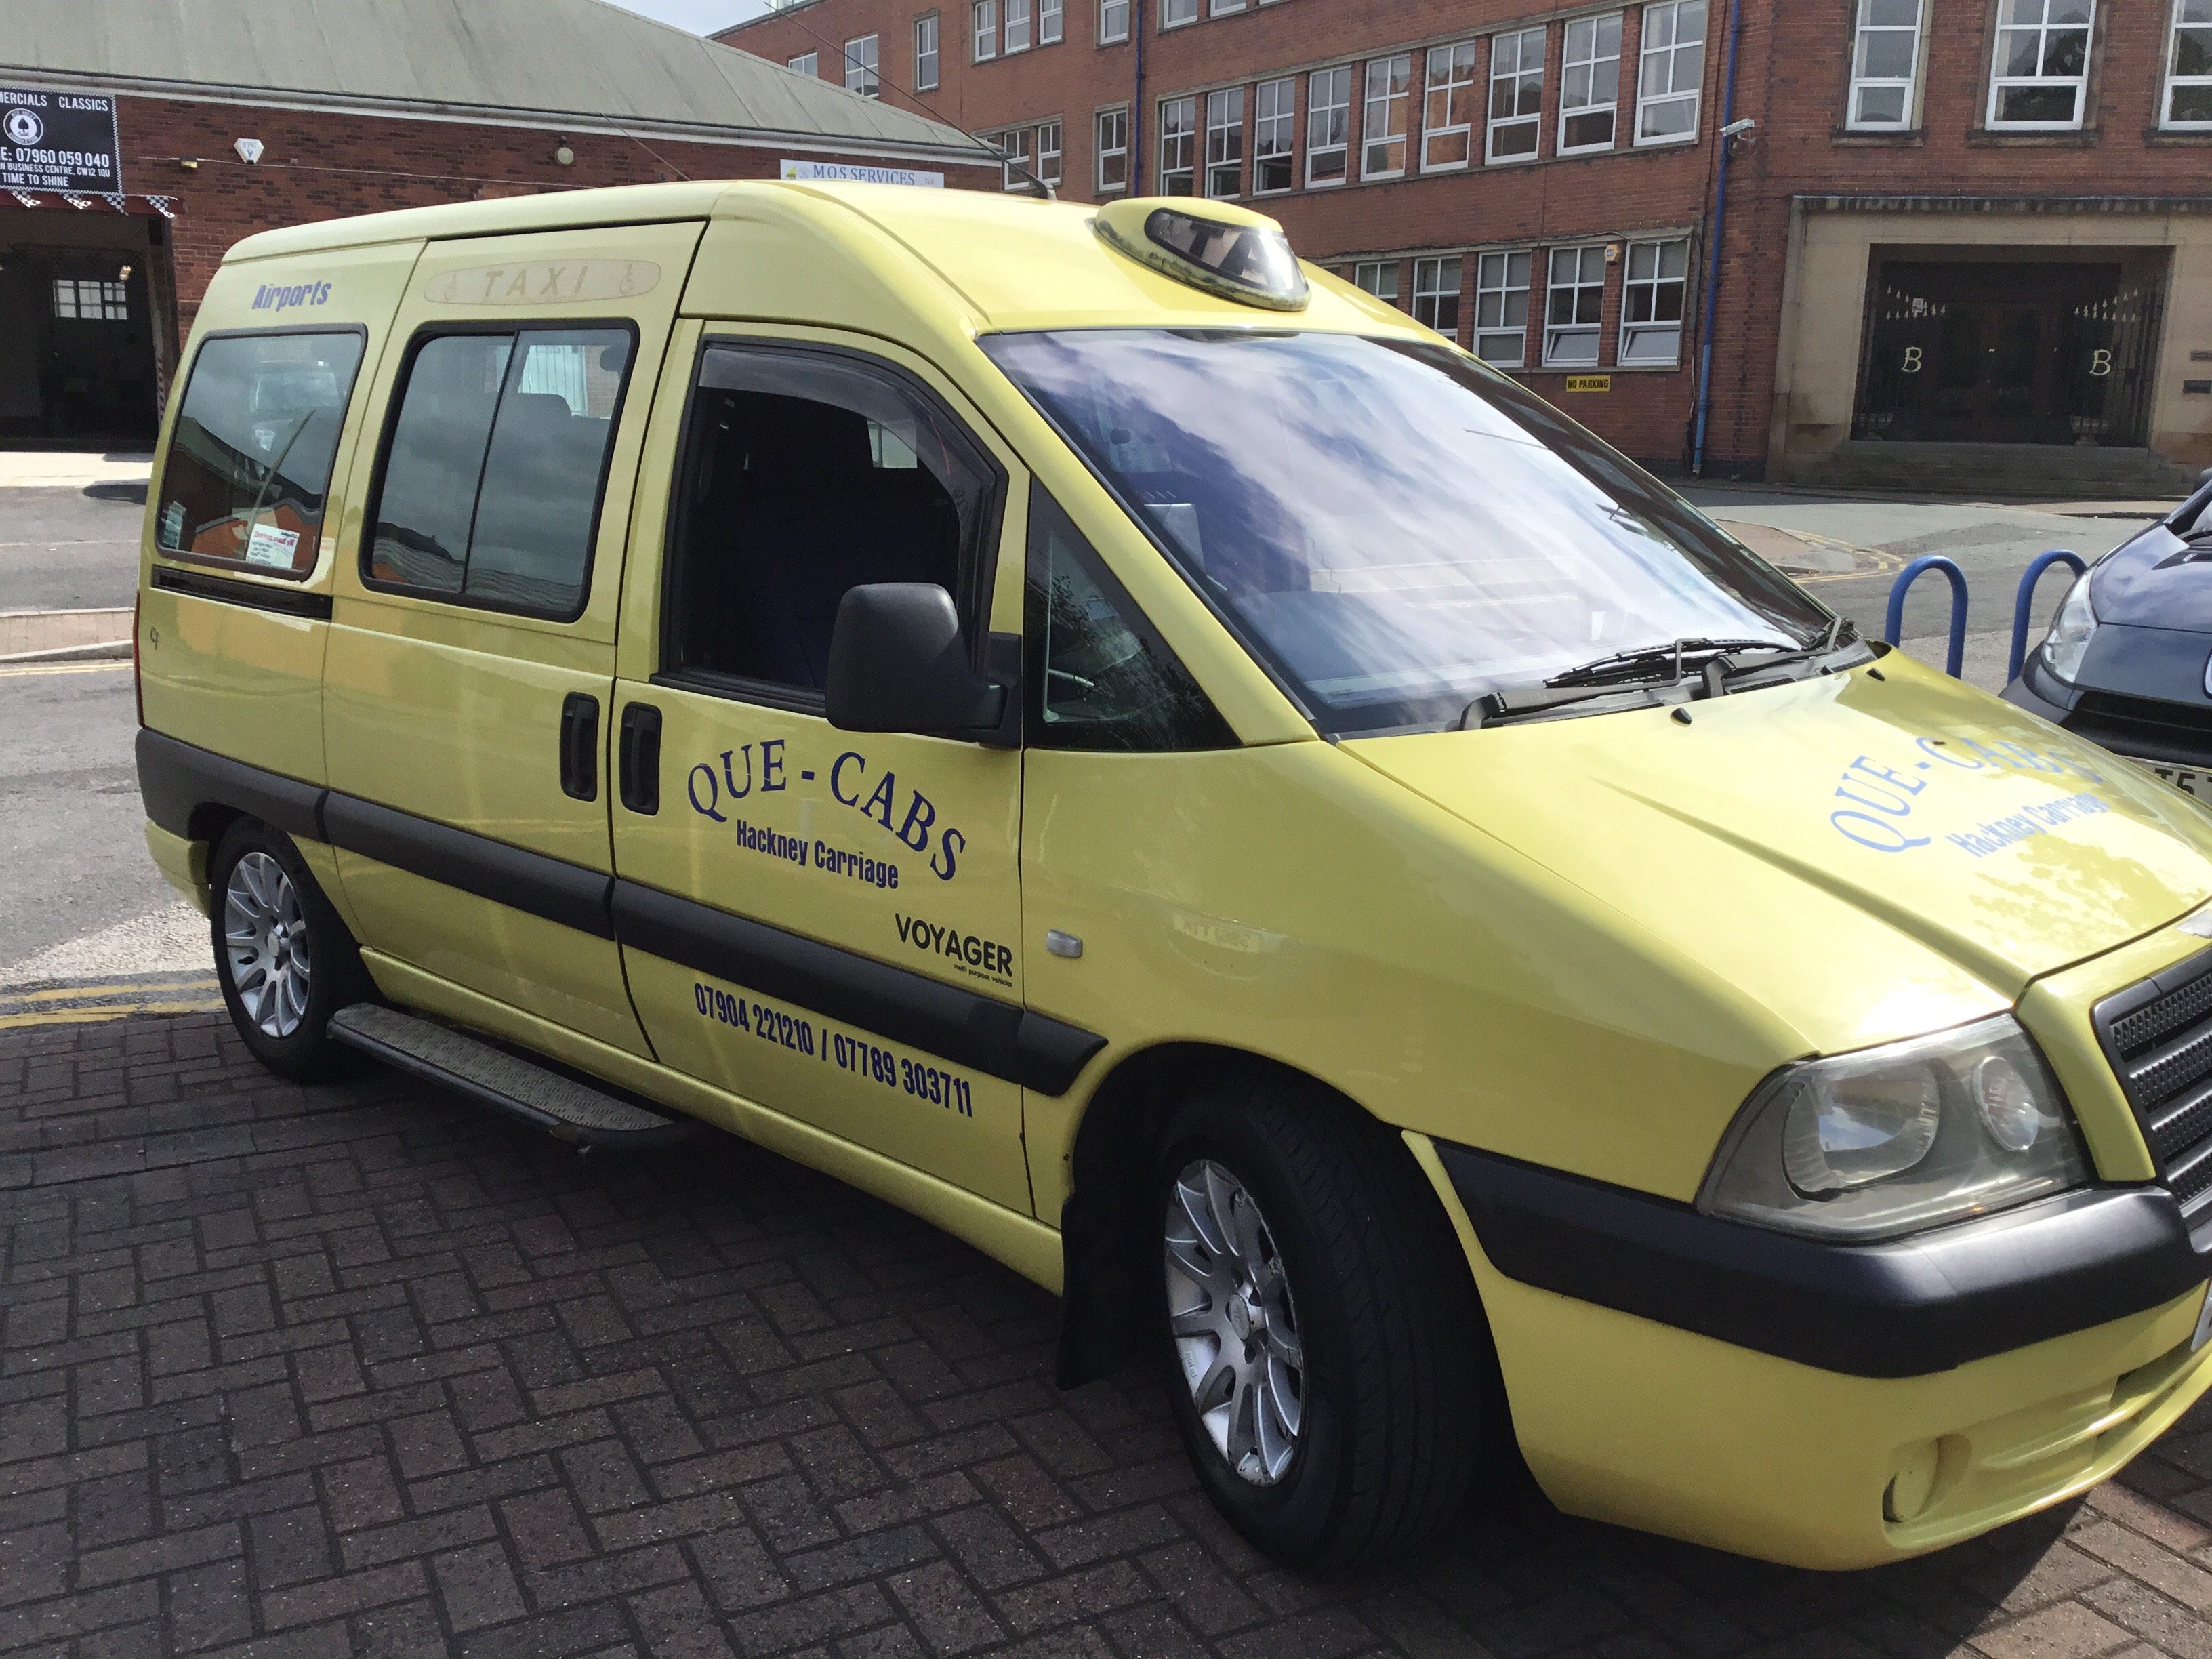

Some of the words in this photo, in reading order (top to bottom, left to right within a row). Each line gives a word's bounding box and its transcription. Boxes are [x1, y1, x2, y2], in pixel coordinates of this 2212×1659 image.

[58, 96, 108, 111] CLASSICS
[7, 163, 43, 173] BUSINESS
[76, 167, 96, 176] CW12
[16, 148, 56, 164] 07960
[58, 150, 82, 166] 059
[85, 152, 109, 167] 040
[1, 172, 25, 184] TIME
[27, 173, 39, 185] TO
[42, 175, 69, 186] SHINE
[850, 167, 915, 186] SERVICES
[485, 266, 588, 297] TAXI
[251, 279, 332, 312] Airports
[1901, 346, 1922, 372] B
[2089, 349, 2112, 375] B
[1568, 380, 1577, 389] NO
[1579, 379, 1609, 388] PARKING
[688, 739, 787, 822] QUE
[830, 752, 966, 881] CABS
[1945, 813, 2048, 857] Hackney
[737, 819, 808, 867] Hackney
[815, 840, 899, 889] Carriage
[895, 913, 1013, 977] VOYAGER
[954, 964, 967, 972] multi
[968, 969, 990, 981] purpose
[991, 977, 1013, 988] vehicles
[694, 983, 750, 1032] 07904
[753, 1004, 815, 1055] 221210
[834, 1033, 897, 1087] 07789
[901, 1058, 973, 1118] 303711
